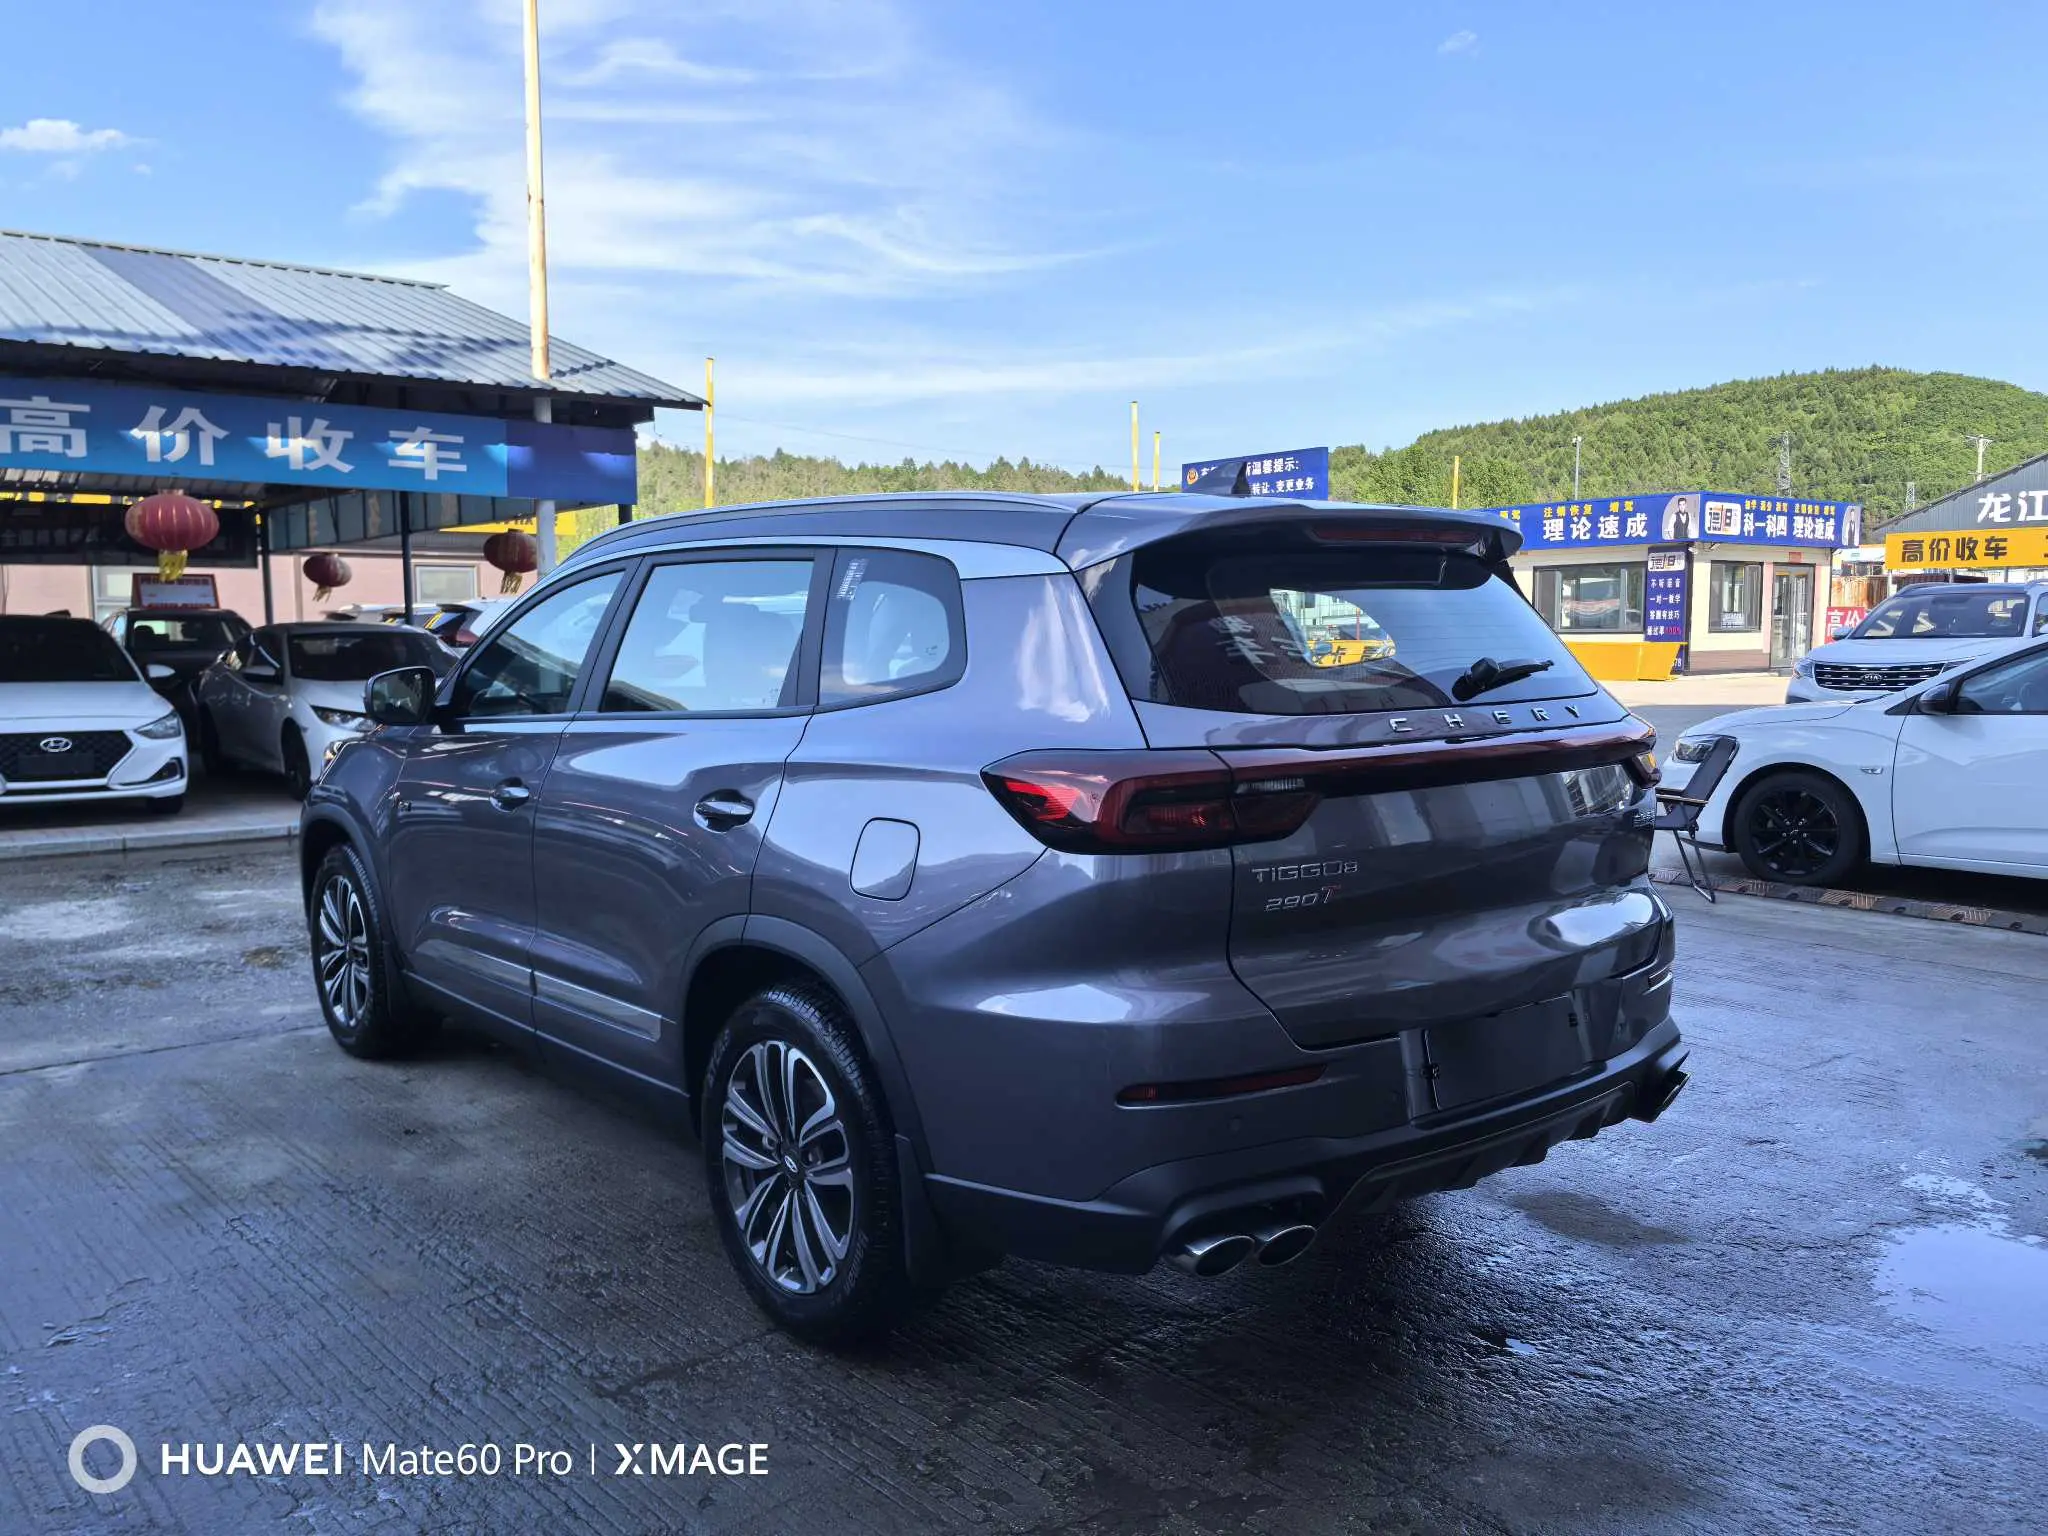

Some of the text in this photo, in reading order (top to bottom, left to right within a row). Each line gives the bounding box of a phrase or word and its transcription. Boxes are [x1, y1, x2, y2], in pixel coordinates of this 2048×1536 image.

[0, 395, 468, 481] 高价收车
[1977, 490, 2048, 523] 龙江
[1543, 512, 1648, 542] 理论速成
[1743, 512, 1788, 538] 科一科四
[1792, 515, 1836, 541] 理论速成
[1901, 536, 2008, 563] 高价收车
[1650, 594, 1681, 604] 一对一教学
[1389, 705, 1580, 732] CHERY
[1264, 884, 1341, 911] 290T
